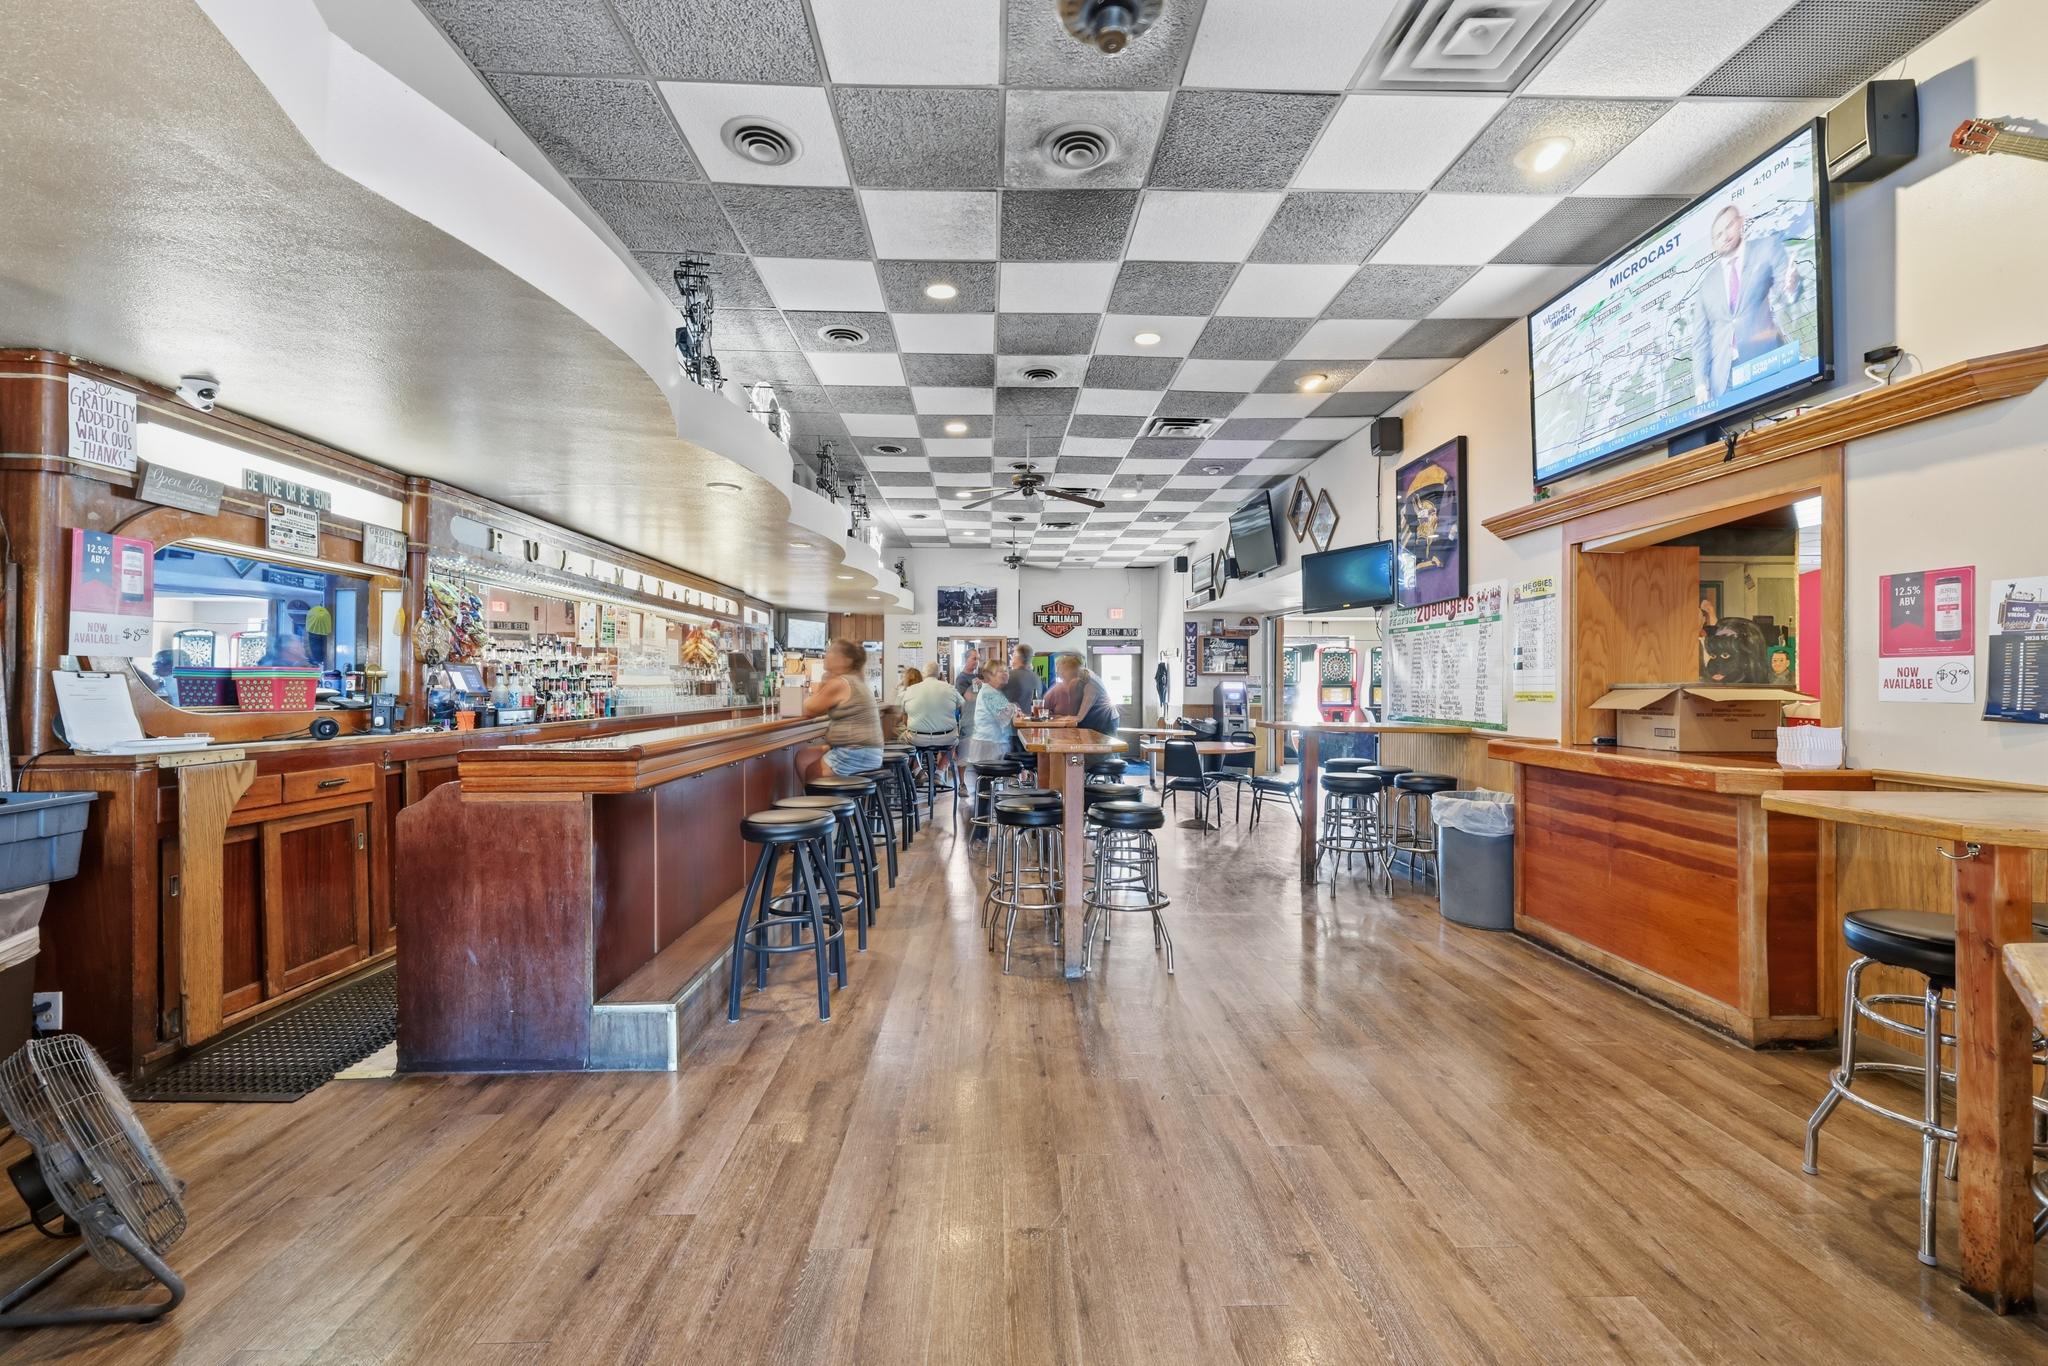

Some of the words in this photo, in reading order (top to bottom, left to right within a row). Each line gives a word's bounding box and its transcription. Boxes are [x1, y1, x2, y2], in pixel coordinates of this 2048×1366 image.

[1731, 186, 1745, 201] FRI
[1753, 170, 1772, 186] 4:10
[1774, 157, 1790, 174] PM
[1609, 233, 1682, 289] MICROCAST
[1542, 303, 1571, 325] WEATHER
[1551, 307, 1577, 330] IMPACT
[87, 381, 112, 397] 20%
[70, 387, 135, 422] GRATUITY
[78, 407, 114, 430] ADDED
[114, 417, 129, 433] TO
[76, 421, 108, 445] WALK
[111, 432, 132, 450] OUTS
[80, 441, 127, 467] THANKS!
[153, 468, 181, 489] Open
[247, 471, 258, 492] BE
[263, 474, 282, 498] NICE
[286, 482, 297, 502] OR
[300, 486, 310, 506] BE
[313, 489, 331, 512] GONE
[369, 527, 394, 538] GROUP
[87, 544, 111, 556] 12.5%
[90, 554, 106, 565] ABV
[1522, 578, 1552, 593] HEGGIES
[1895, 586, 1921, 596] 12.5%
[1047, 604, 1069, 614] CLUB
[1899, 596, 1916, 607] ABV
[1037, 615, 1049, 623] THE
[1050, 615, 1079, 623] PULLMAN
[87, 622, 108, 633] NOW
[74, 632, 120, 645] AVAILABLE
[1185, 635, 1196, 686] WELCOME
[1897, 667, 1919, 678] NOW
[1883, 678, 1933, 690] AVAILABLE
